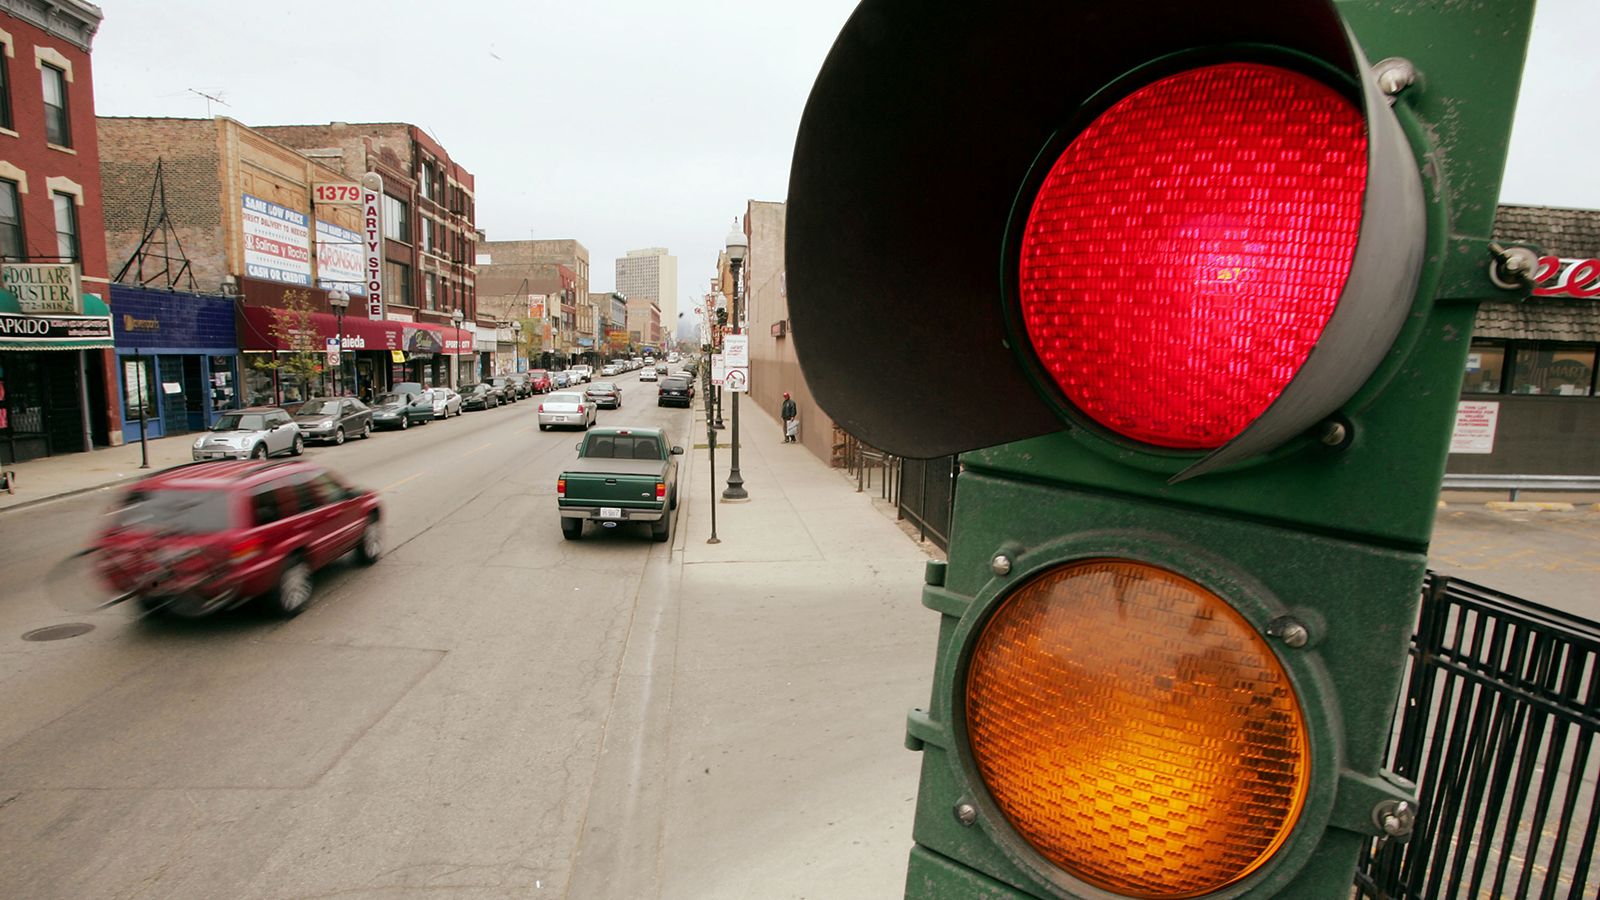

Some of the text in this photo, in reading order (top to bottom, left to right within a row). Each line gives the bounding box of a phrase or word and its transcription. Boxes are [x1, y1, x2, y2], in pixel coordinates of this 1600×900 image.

[316, 186, 360, 200] 1379
[245, 197, 304, 225] SAME LOW PRICE
[283, 223, 290, 233] TO
[255, 237, 279, 254] Salinas
[287, 247, 308, 261] Rocha
[365, 194, 381, 315] PARTY STORE
[10, 267, 63, 284] DOLLAR
[248, 265, 269, 279] CASH
[270, 268, 281, 281] OR
[9, 285, 70, 301] BUSTER
